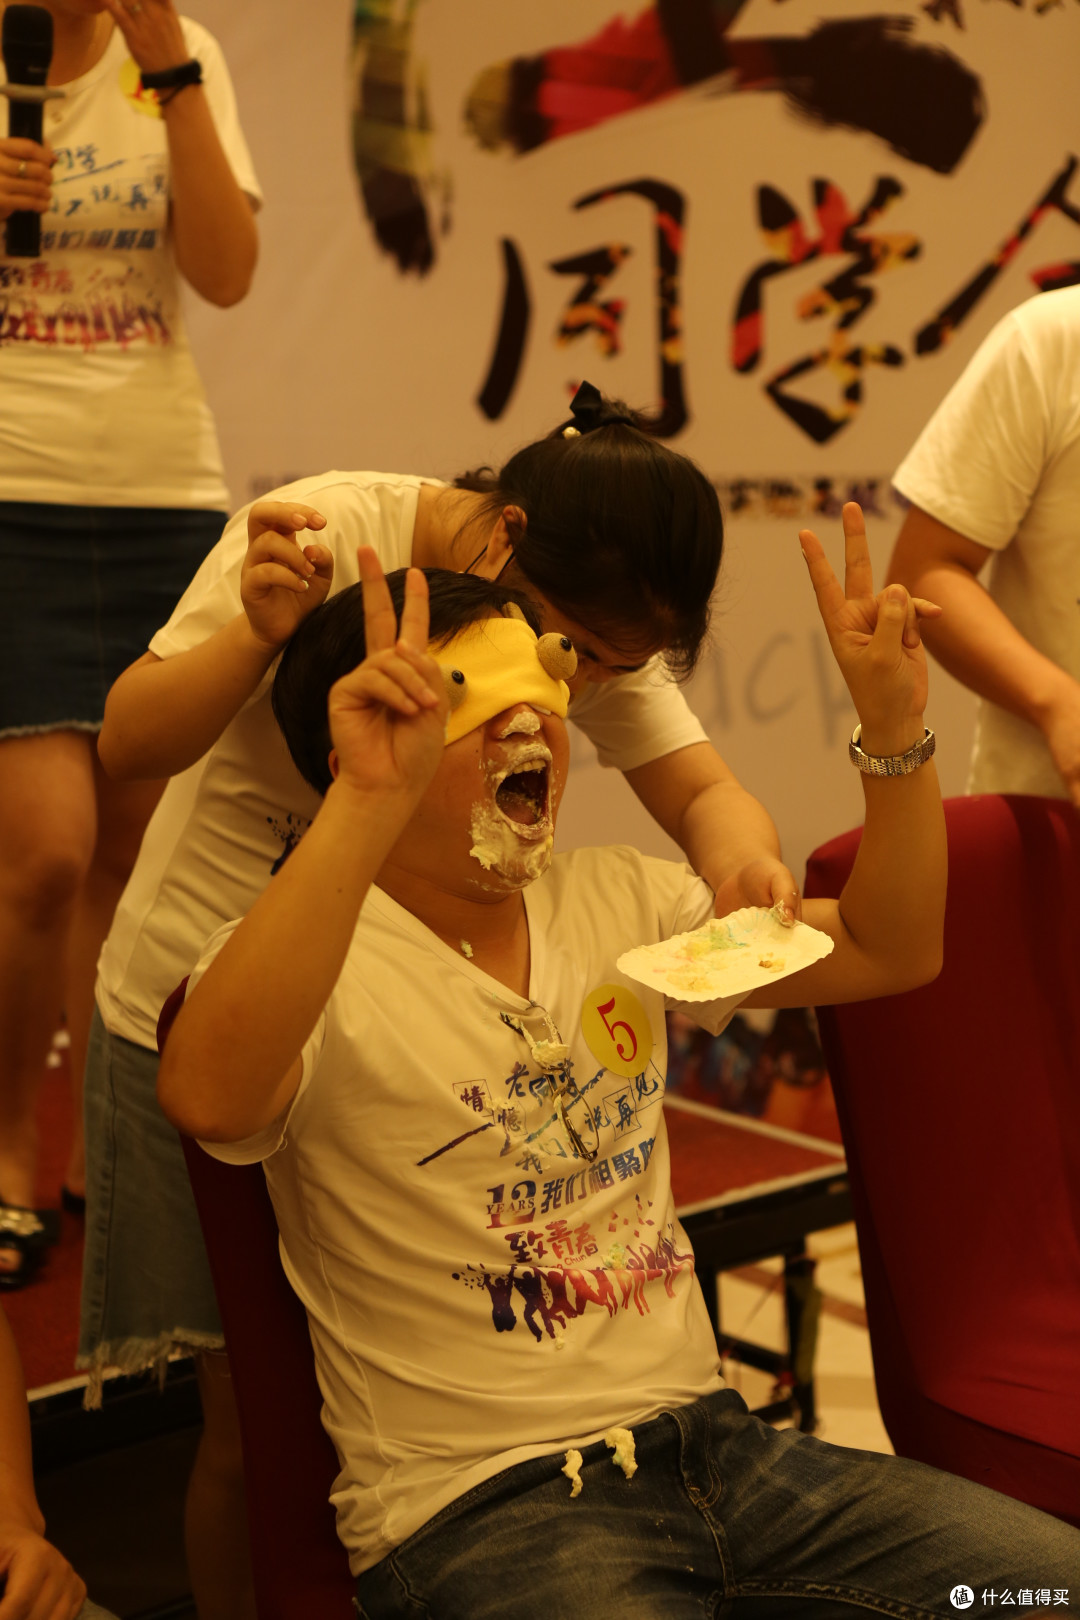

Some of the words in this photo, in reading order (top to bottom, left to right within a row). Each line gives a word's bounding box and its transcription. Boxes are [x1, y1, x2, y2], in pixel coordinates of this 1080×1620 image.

[596, 996, 638, 1062] 5
[486, 1197, 535, 1215] YEARS
[504, 1219, 599, 1264] 致青春
[563, 1254, 587, 1266] Chun
